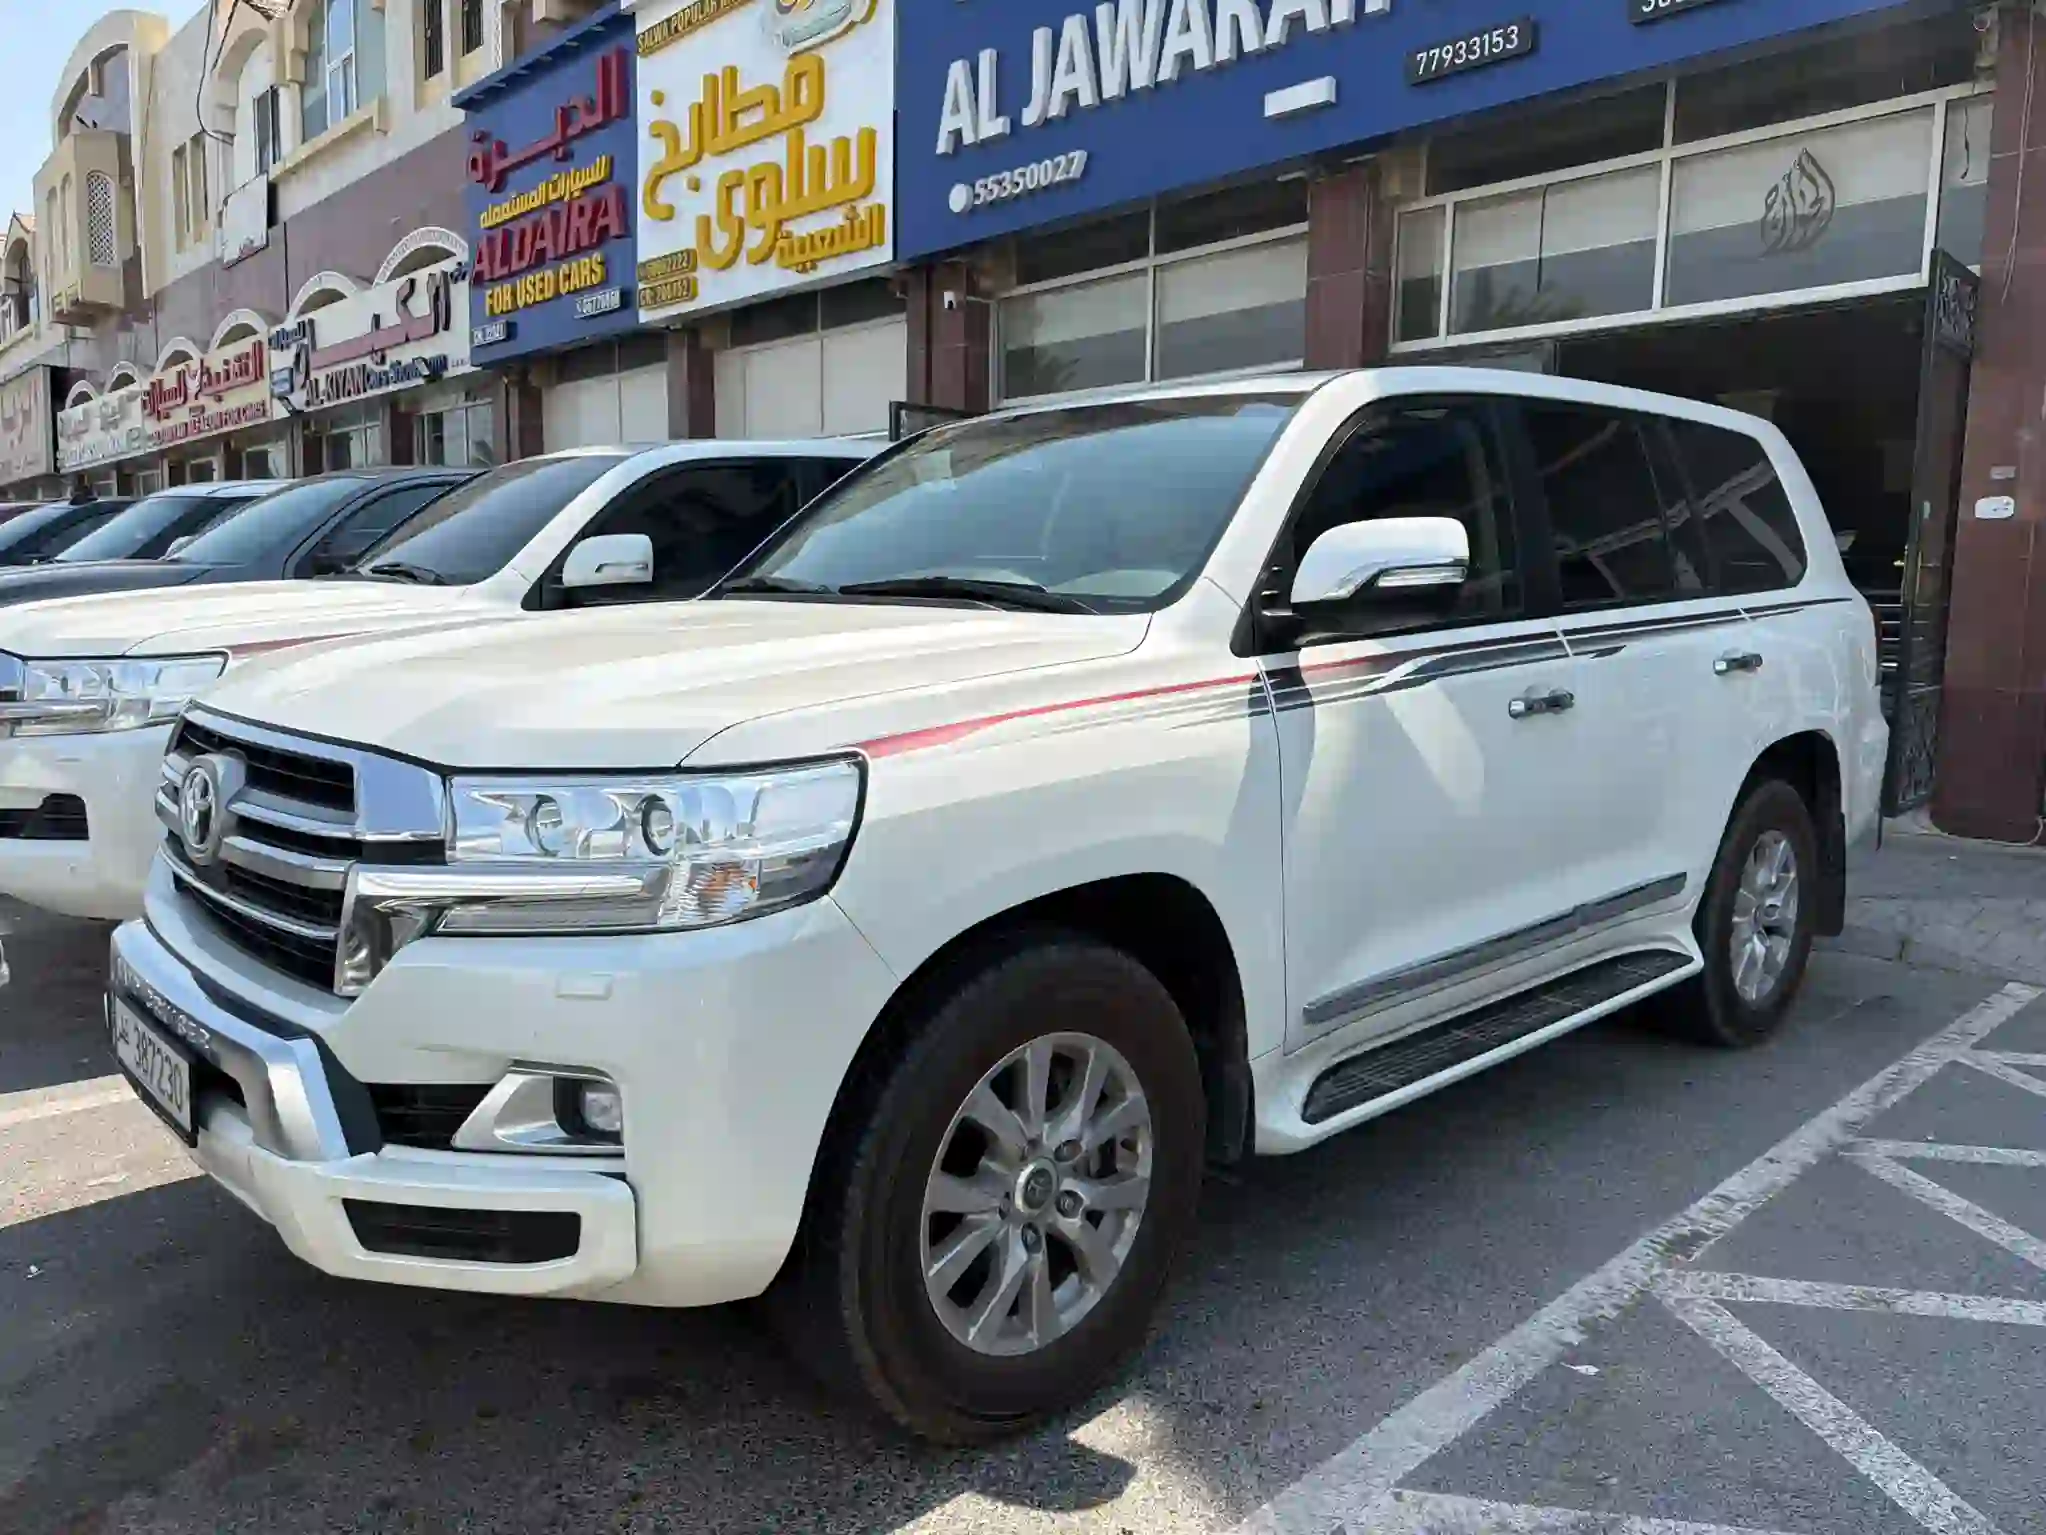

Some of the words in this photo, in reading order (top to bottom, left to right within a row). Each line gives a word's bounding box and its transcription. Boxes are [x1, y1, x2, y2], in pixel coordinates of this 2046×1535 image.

[637, 22, 669, 53] SALWA
[1415, 25, 1519, 76] 77933153
[936, 48, 1010, 154] AL
[1022, 0, 1391, 126] JAWAR
[468, 44, 628, 192] الديرة
[642, 54, 824, 221] مطابخ
[549, 155, 613, 202] للسيارات
[696, 126, 877, 269] سلوى
[972, 150, 1088, 206] 55350027
[473, 184, 628, 282] ALDAIRA
[776, 202, 886, 274] الشعبية
[485, 288, 513, 317] FOR
[516, 271, 556, 308] USED
[559, 252, 605, 295] CARS
[305, 363, 366, 407] AL-KIYAN
[133, 1023, 184, 1114] 387230
